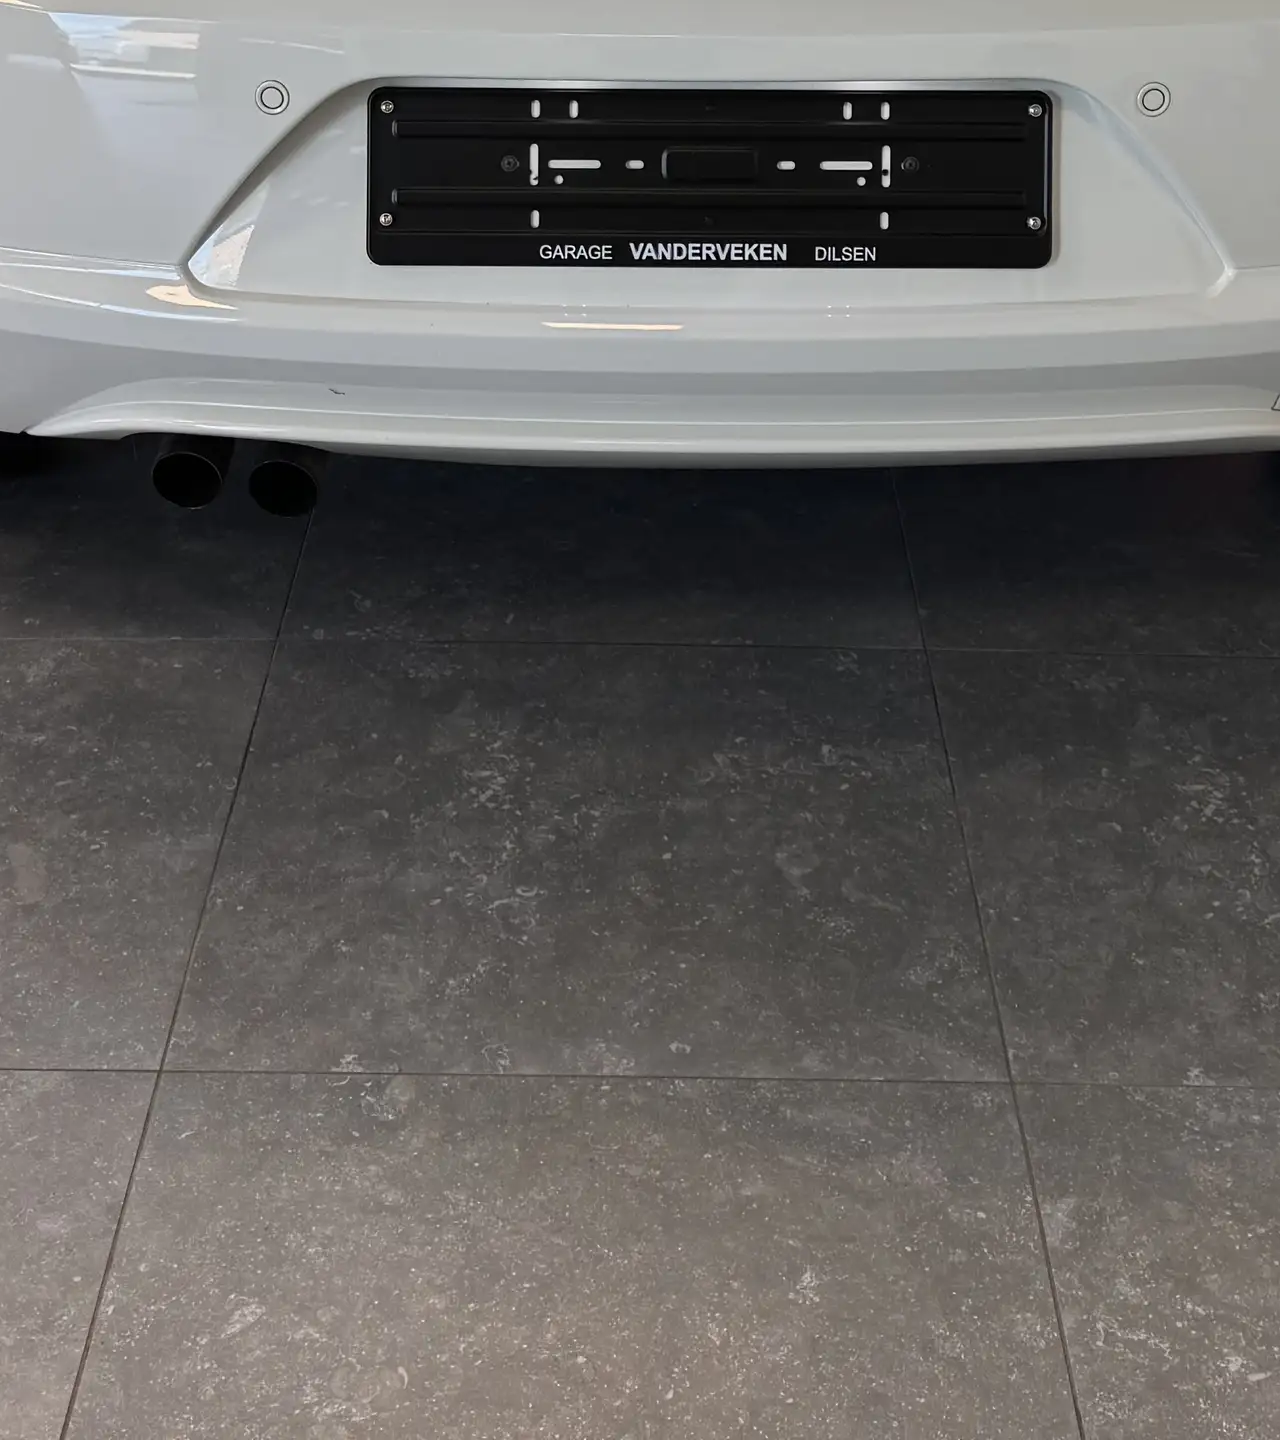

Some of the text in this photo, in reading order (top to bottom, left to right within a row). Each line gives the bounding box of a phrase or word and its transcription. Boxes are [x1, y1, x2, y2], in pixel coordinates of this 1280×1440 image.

[539, 242, 877, 262] GARAGE VANDERVEKEN DILSEN
